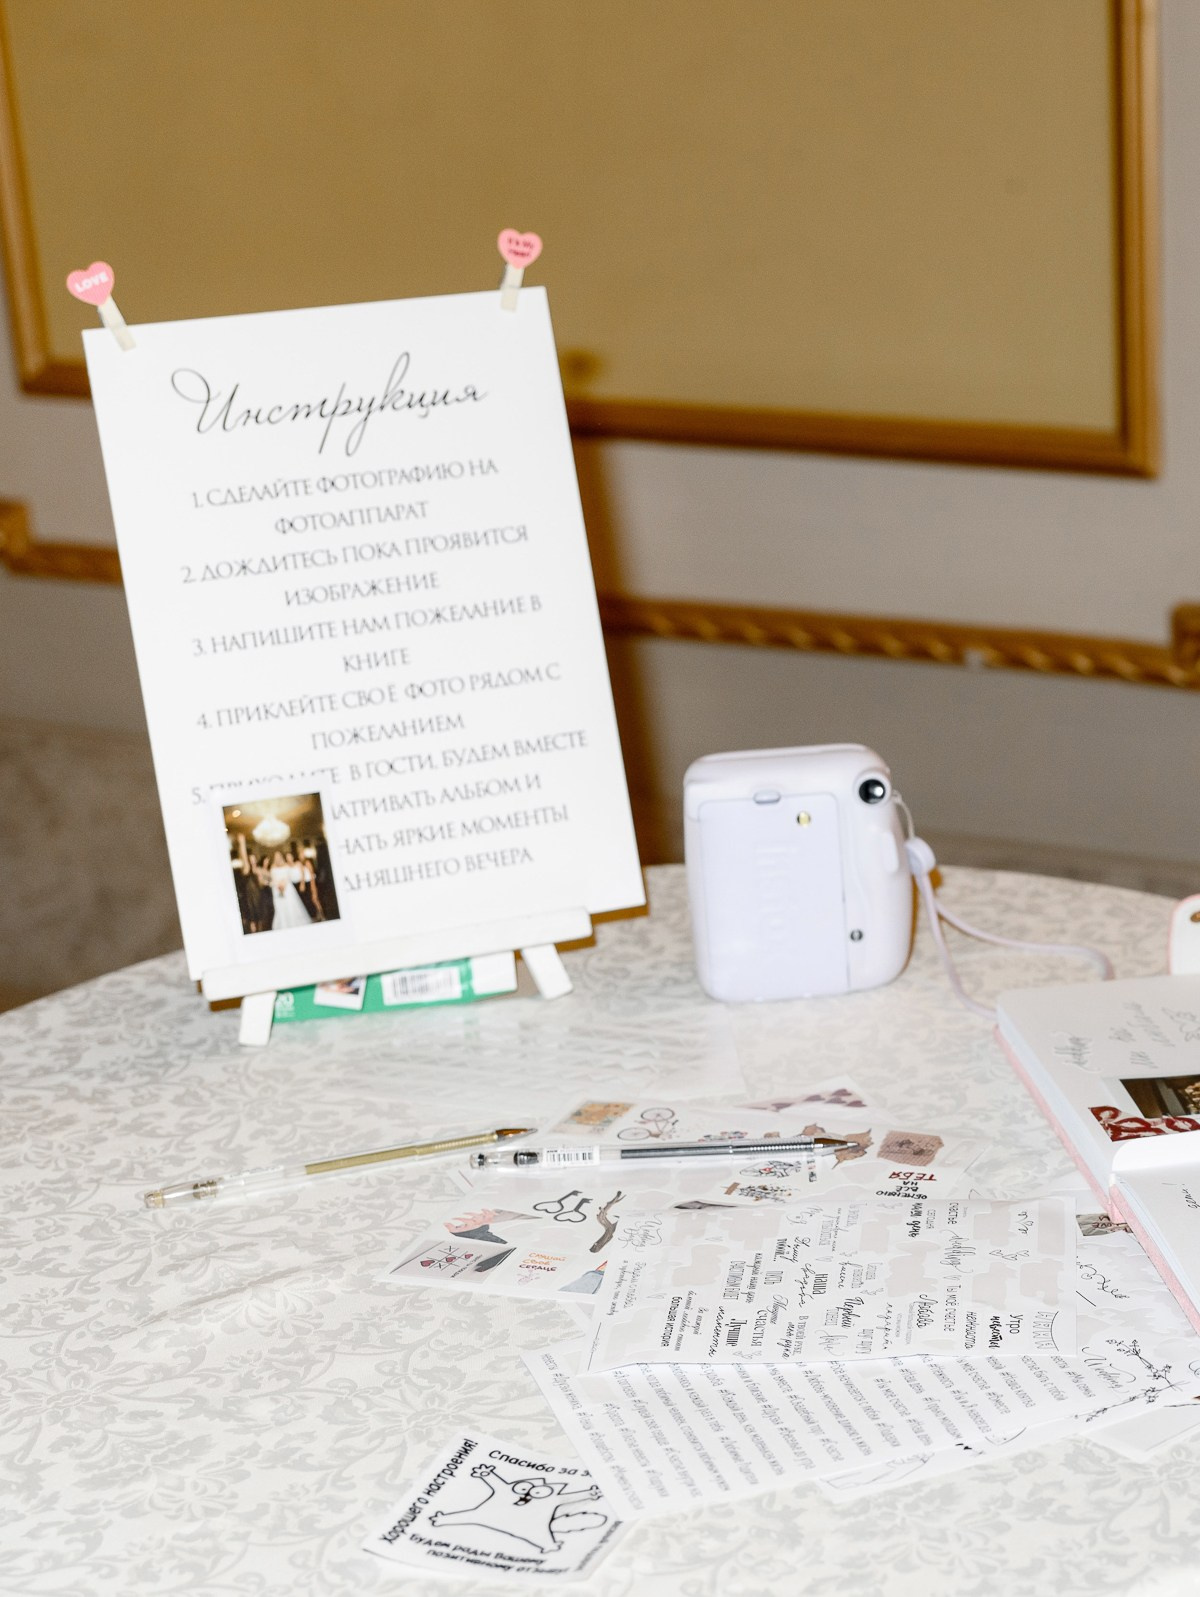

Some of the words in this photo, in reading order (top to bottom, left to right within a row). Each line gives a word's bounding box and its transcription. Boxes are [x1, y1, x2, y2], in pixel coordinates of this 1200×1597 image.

[171, 351, 487, 456] Инструкция
[192, 492, 204, 509] 1.
[206, 478, 312, 506] СДЕЛАЙТЕ
[316, 461, 465, 494] ФОТОГРАФИЮ
[468, 459, 499, 477] НА
[274, 501, 428, 535] ФОТОАППАРАТ
[180, 566, 194, 584] 2.
[201, 549, 338, 582] ДОЖДИТЕСЬ
[342, 542, 402, 564] ПОКА
[404, 524, 528, 556] ПРОЯВИТСЯ
[284, 572, 439, 606] ИЗОБРАЖЕНИЕ
[192, 638, 207, 657] 3.
[211, 621, 337, 654] НАПИШИТЕ
[342, 615, 391, 636] НАМ
[394, 596, 525, 630] ПОЖЕЛАНИЕ
[530, 594, 542, 612] В
[342, 648, 409, 673] КНИГЕ
[197, 713, 212, 729] 4.
[216, 694, 338, 727] ПРИКЛЕЙТЕ
[404, 676, 466, 700] ФОТО
[469, 666, 543, 691] РЯДОМ
[545, 662, 561, 681] С
[311, 713, 465, 750] ПОЖЕЛАНИЕМ
[349, 764, 362, 781] В
[365, 754, 438, 779] ГОСТИ,
[441, 743, 510, 768] БУДЕМ
[513, 730, 587, 757] ВМЕСТЕ
[331, 790, 436, 821] АТРИВАТЬ
[440, 777, 522, 804] АЛЬБОМ
[525, 774, 541, 790] И
[393, 822, 456, 848] ЯРКИЕ
[461, 804, 569, 837] МОМЕНТЫ
[464, 847, 534, 872] ВЕЧЕРА
[888, 1171, 937, 1181] ТЕБЯ
[906, 1220, 922, 1238] день
[947, 1202, 960, 1225] счастье
[811, 1273, 829, 1295] наша
[947, 1284, 961, 1293] Ты
[666, 1296, 683, 1322] большая
[912, 1294, 939, 1329] Любовь
[943, 1307, 957, 1333] счастье
[1005, 1314, 1024, 1335] Утро
[660, 1322, 675, 1348] история
[707, 1305, 725, 1358] моменты
[725, 1318, 748, 1348] Лучшие
[750, 1309, 770, 1348] счастья
[795, 1321, 808, 1340] ТВОЕЙ
[964, 1311, 979, 1350] нежность
[988, 1315, 1003, 1349] невесты
[488, 1449, 556, 1472] Спасибо
[558, 1467, 578, 1475] за
[378, 1497, 429, 1544] Хорошего
[422, 1438, 479, 1497] настроения!
[409, 1533, 451, 1548] Будем
[452, 1544, 491, 1557] рады
[426, 1549, 514, 1572] позитивному
